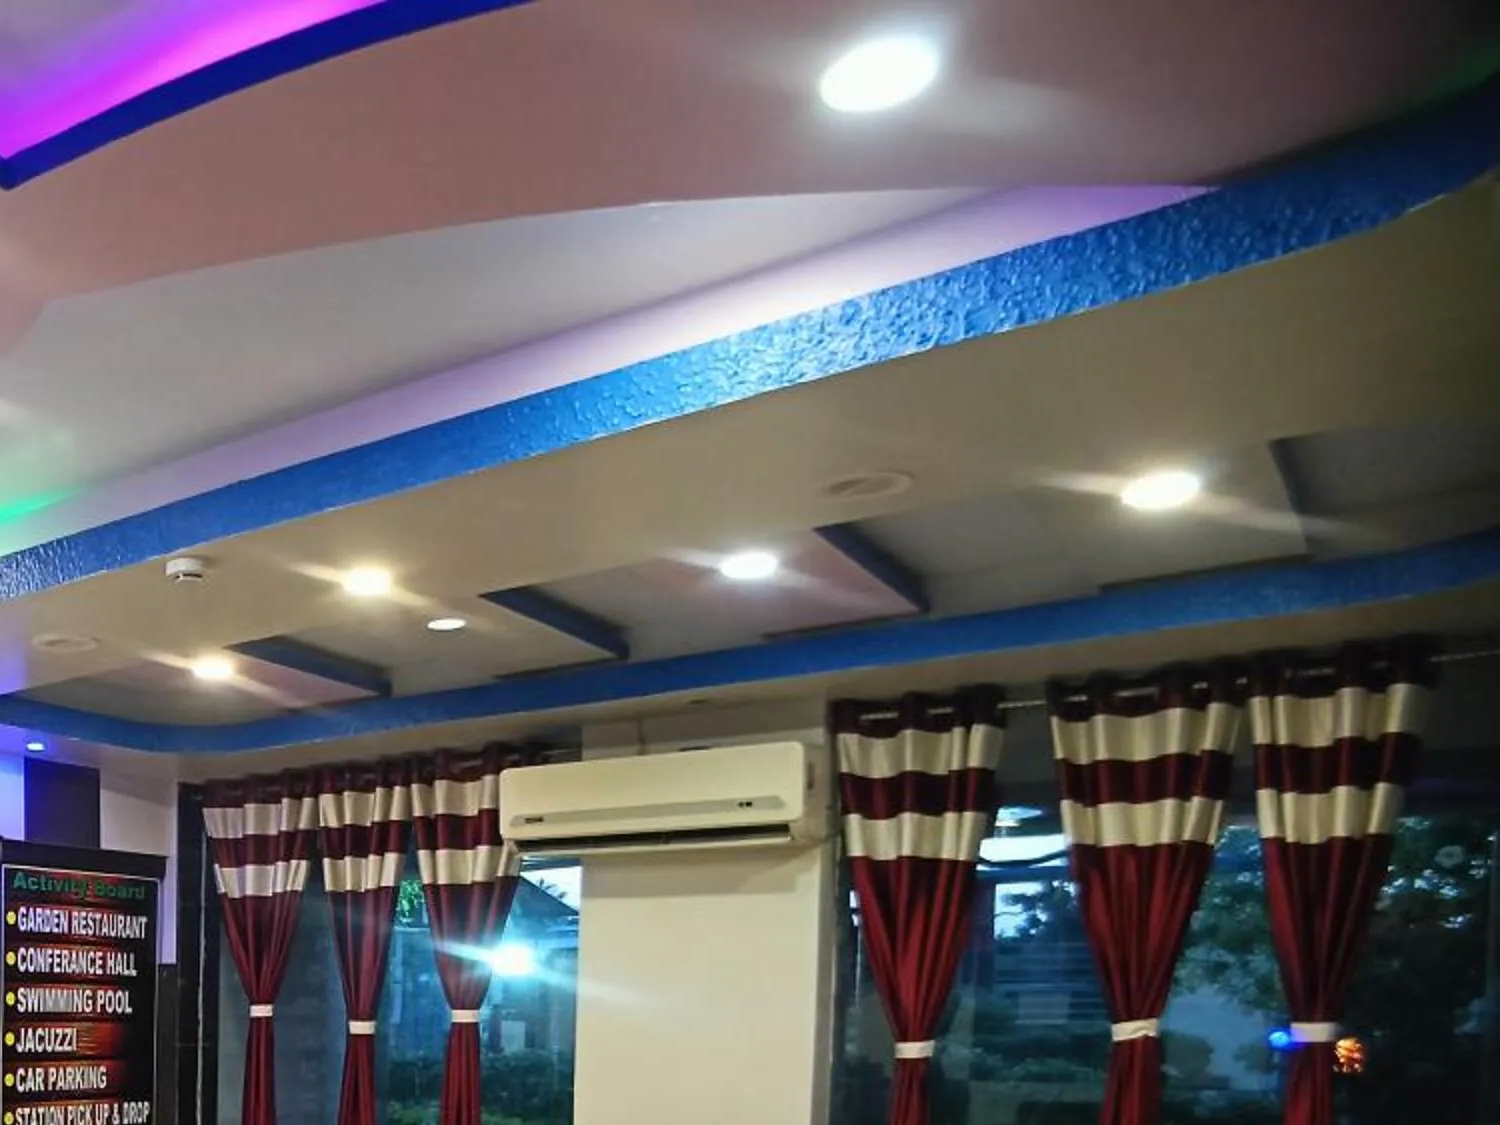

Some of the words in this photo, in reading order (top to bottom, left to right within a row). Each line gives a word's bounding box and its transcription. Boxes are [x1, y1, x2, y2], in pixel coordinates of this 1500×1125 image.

[13, 872, 88, 897] Activity
[95, 878, 145, 899] Board
[18, 907, 69, 934] GARDEN
[71, 911, 148, 939] RESTAURANT
[17, 948, 103, 974] CONFERANCE
[106, 951, 137, 976] HALL
[17, 987, 93, 1013] SWIMMING
[97, 989, 133, 1014] POOL
[16, 1027, 77, 1053] JACUZZI
[16, 1067, 44, 1092] CAR
[48, 1066, 107, 1090] PARKING
[112, 1103, 119, 1125] &
[123, 1101, 150, 1125] DROP
